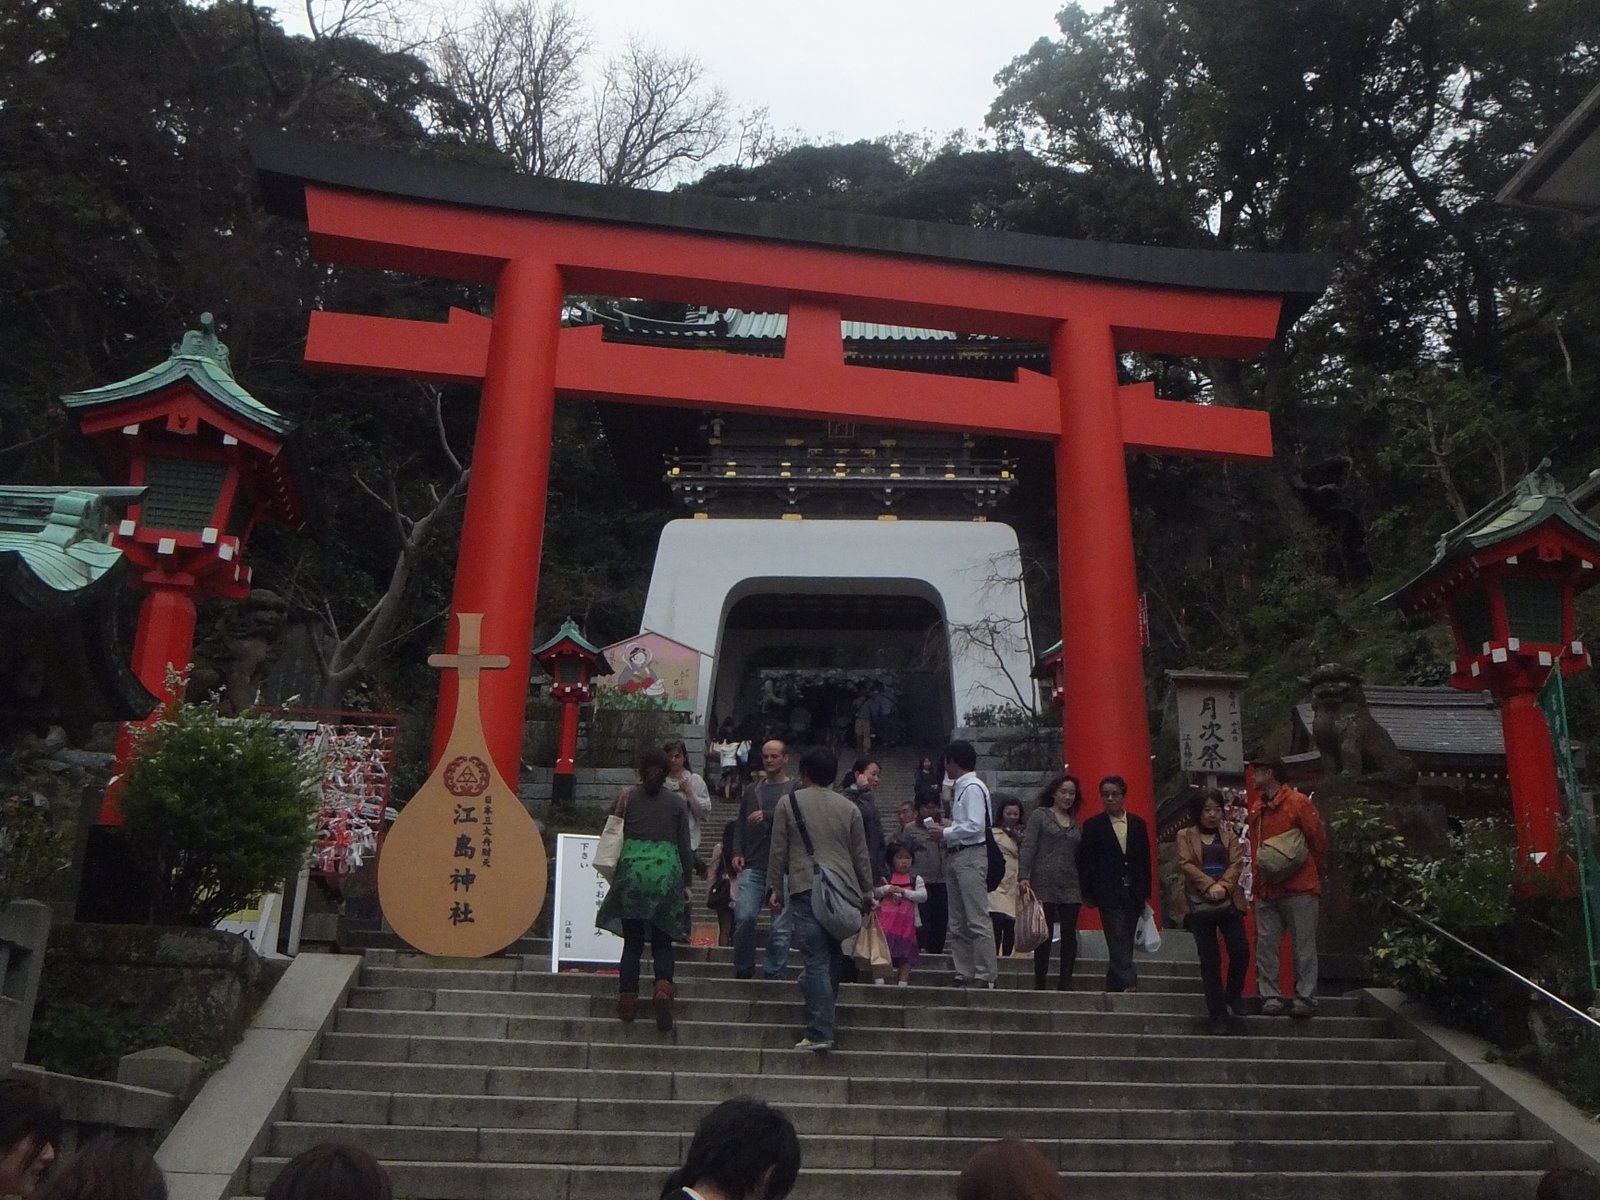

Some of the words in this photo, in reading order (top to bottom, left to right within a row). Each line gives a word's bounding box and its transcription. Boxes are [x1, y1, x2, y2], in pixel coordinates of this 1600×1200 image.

[1197, 695, 1227, 770] 月次祭
[448, 803, 479, 926] 江島神社
[580, 842, 589, 869] 下さい
